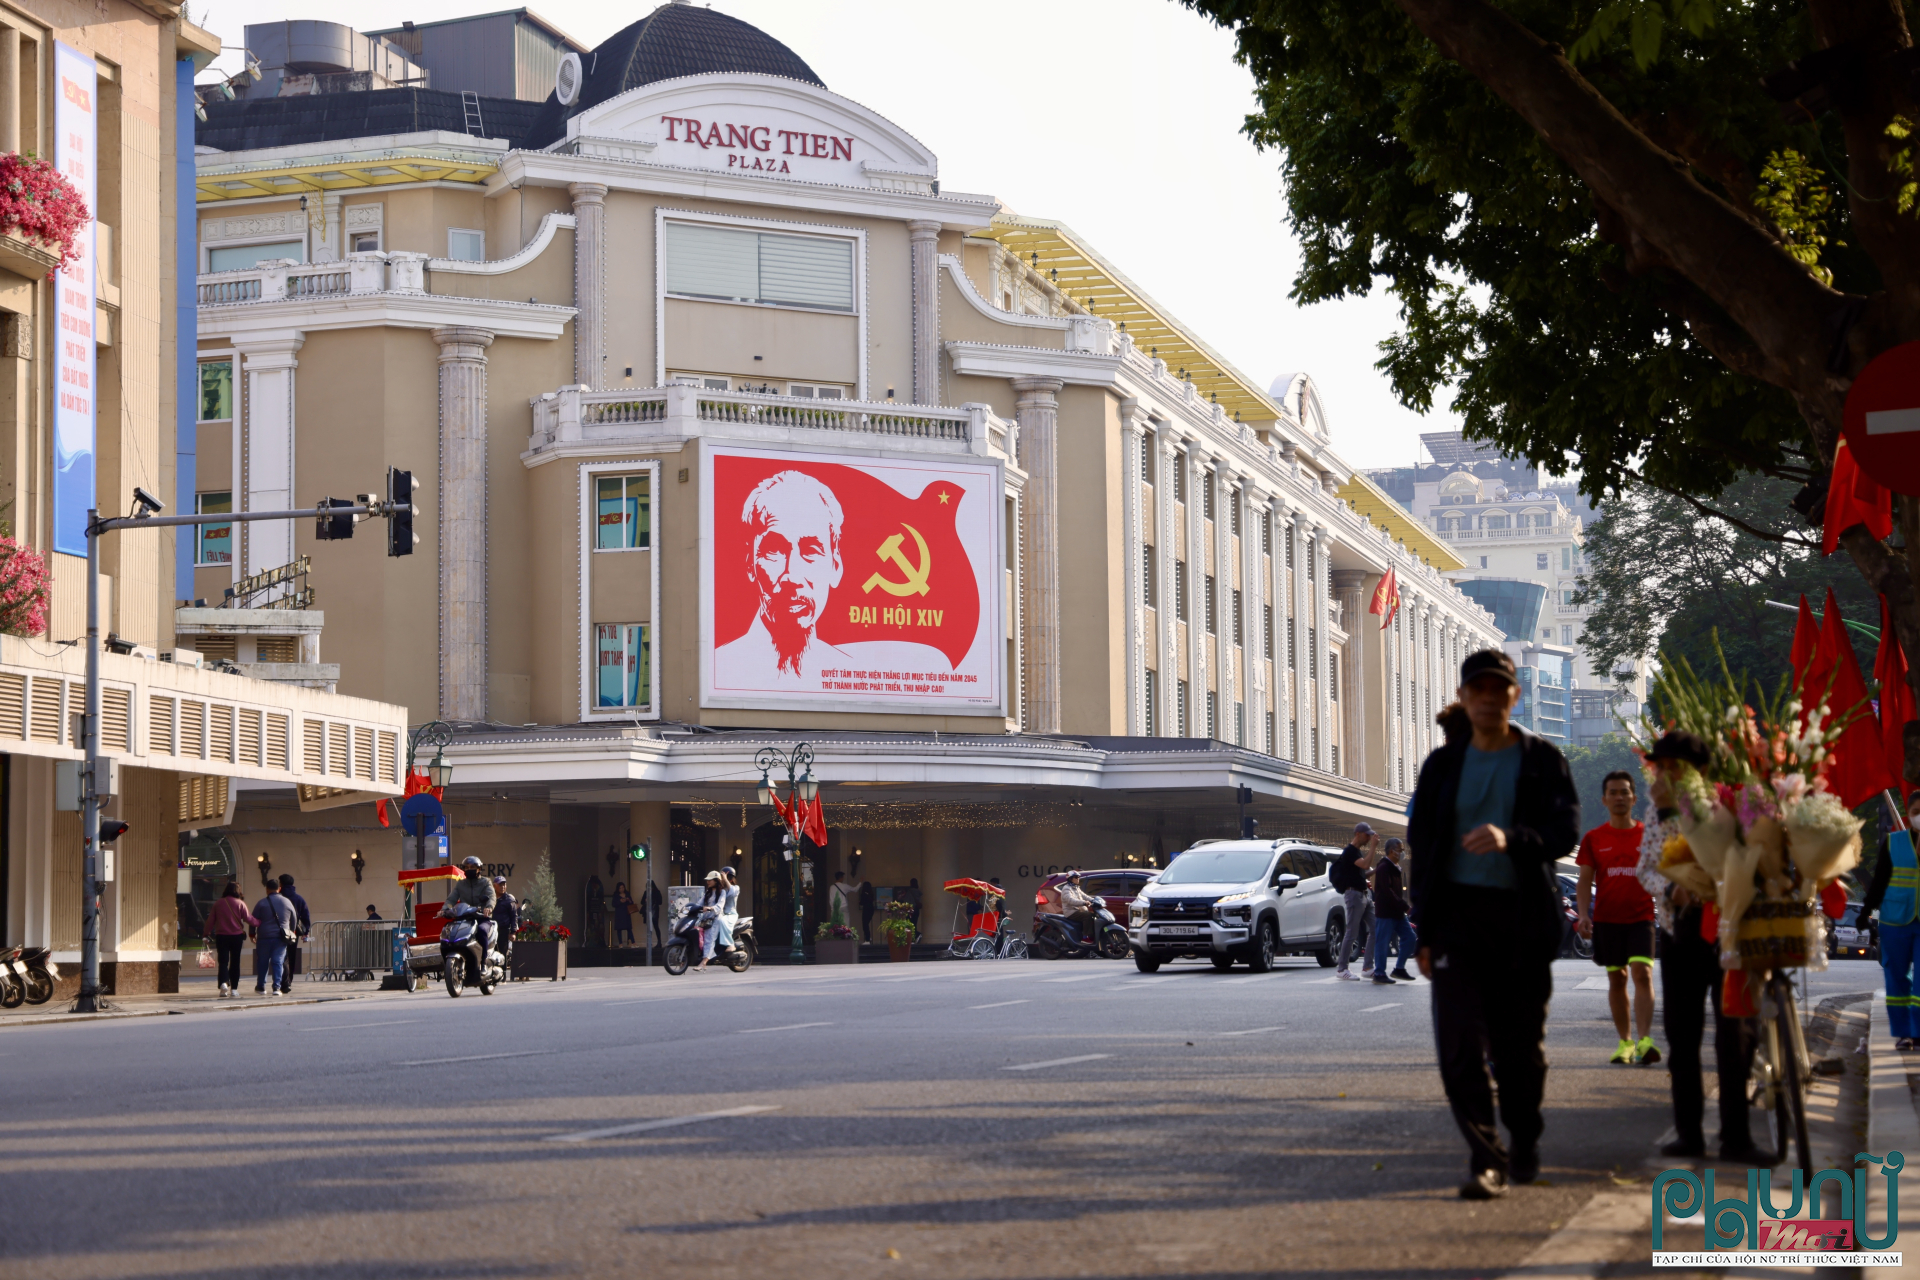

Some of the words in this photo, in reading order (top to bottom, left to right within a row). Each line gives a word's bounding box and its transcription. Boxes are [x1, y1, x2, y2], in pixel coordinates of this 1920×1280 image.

[661, 115, 771, 151] TRANG
[778, 129, 854, 161] TIEN
[728, 154, 791, 173] PLAZA
[849, 606, 877, 628] ĐẠI
[883, 603, 911, 629] HỘI
[917, 609, 943, 627] XIV
[822, 668, 838, 678] QUYẾT
[840, 669, 851, 678] TÂM
[853, 670, 867, 680] THỰC
[869, 670, 881, 681] HIỆN
[883, 669, 900, 680] THẮNG
[902, 672, 910, 682] LỢI
[912, 673, 924, 682] MỤC
[926, 672, 937, 682] TIÊU
[938, 671, 949, 682] ĐẾN
[950, 673, 963, 682] NĂM
[822, 679, 832, 690] TRỞ
[834, 680, 852, 690] THÀNH
[853, 681, 868, 691] NƯỚC
[870, 681, 884, 691] PHÁT
[885, 680, 902, 692] TRIỂN,
[904, 684, 914, 692] THU
[915, 684, 930, 694] NHẬP
[932, 685, 944, 693] CAO!
[441, 863, 515, 877] ERRY
[1018, 865, 1081, 877] GUCC
